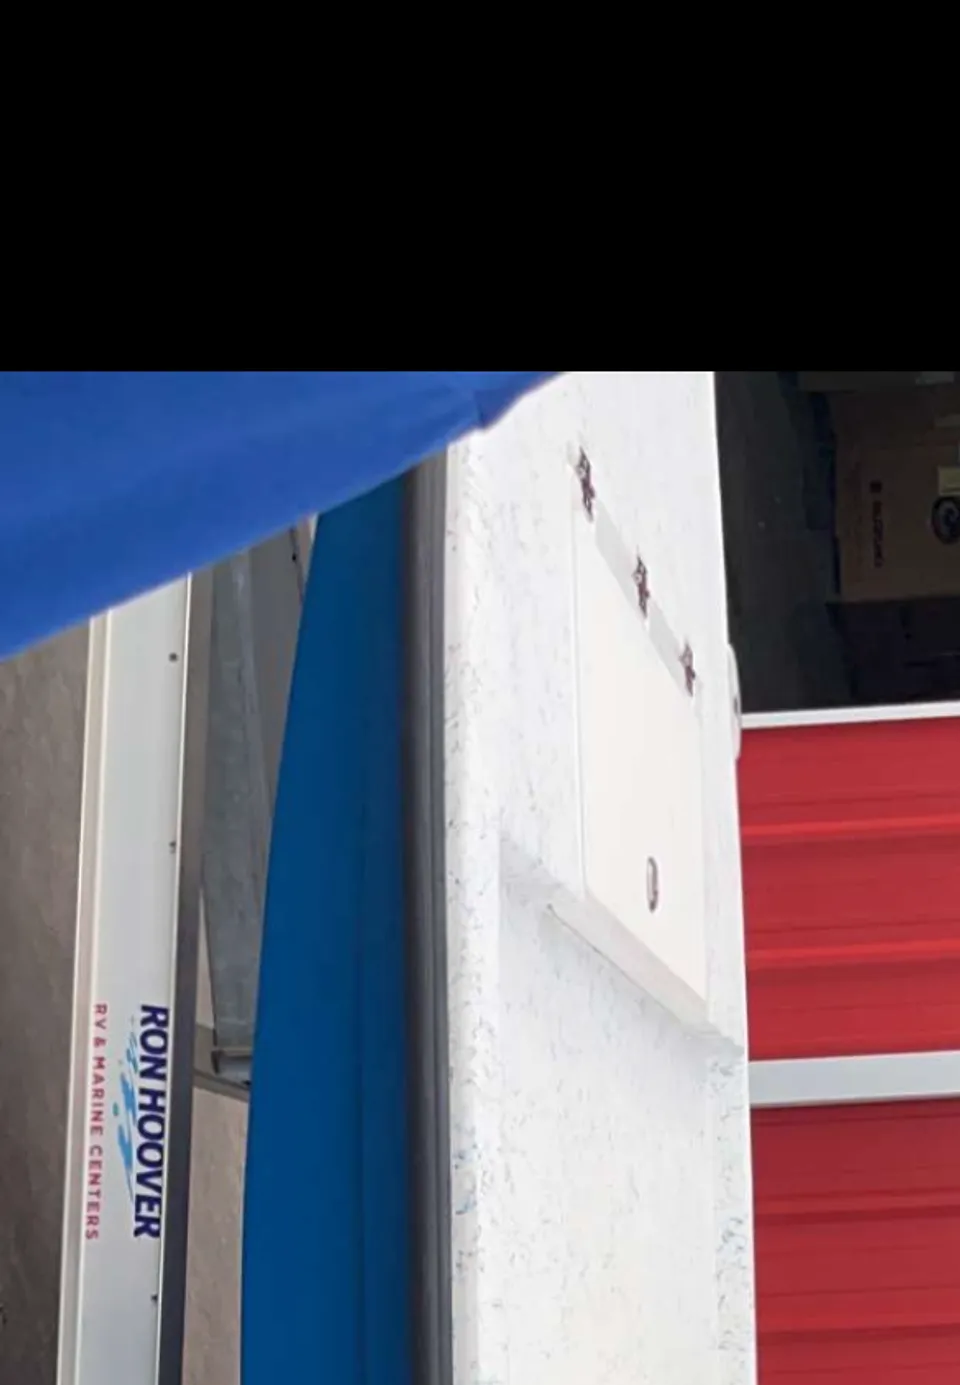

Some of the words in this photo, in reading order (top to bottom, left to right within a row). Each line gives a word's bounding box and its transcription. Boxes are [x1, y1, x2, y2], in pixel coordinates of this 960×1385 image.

[93, 1036, 106, 1049] &
[94, 1003, 108, 1030] RV
[140, 1004, 170, 1081] RON
[90, 1056, 106, 1136] MARINE
[85, 1144, 104, 1240] CENTERS
[134, 1087, 167, 1239] HOOVER
